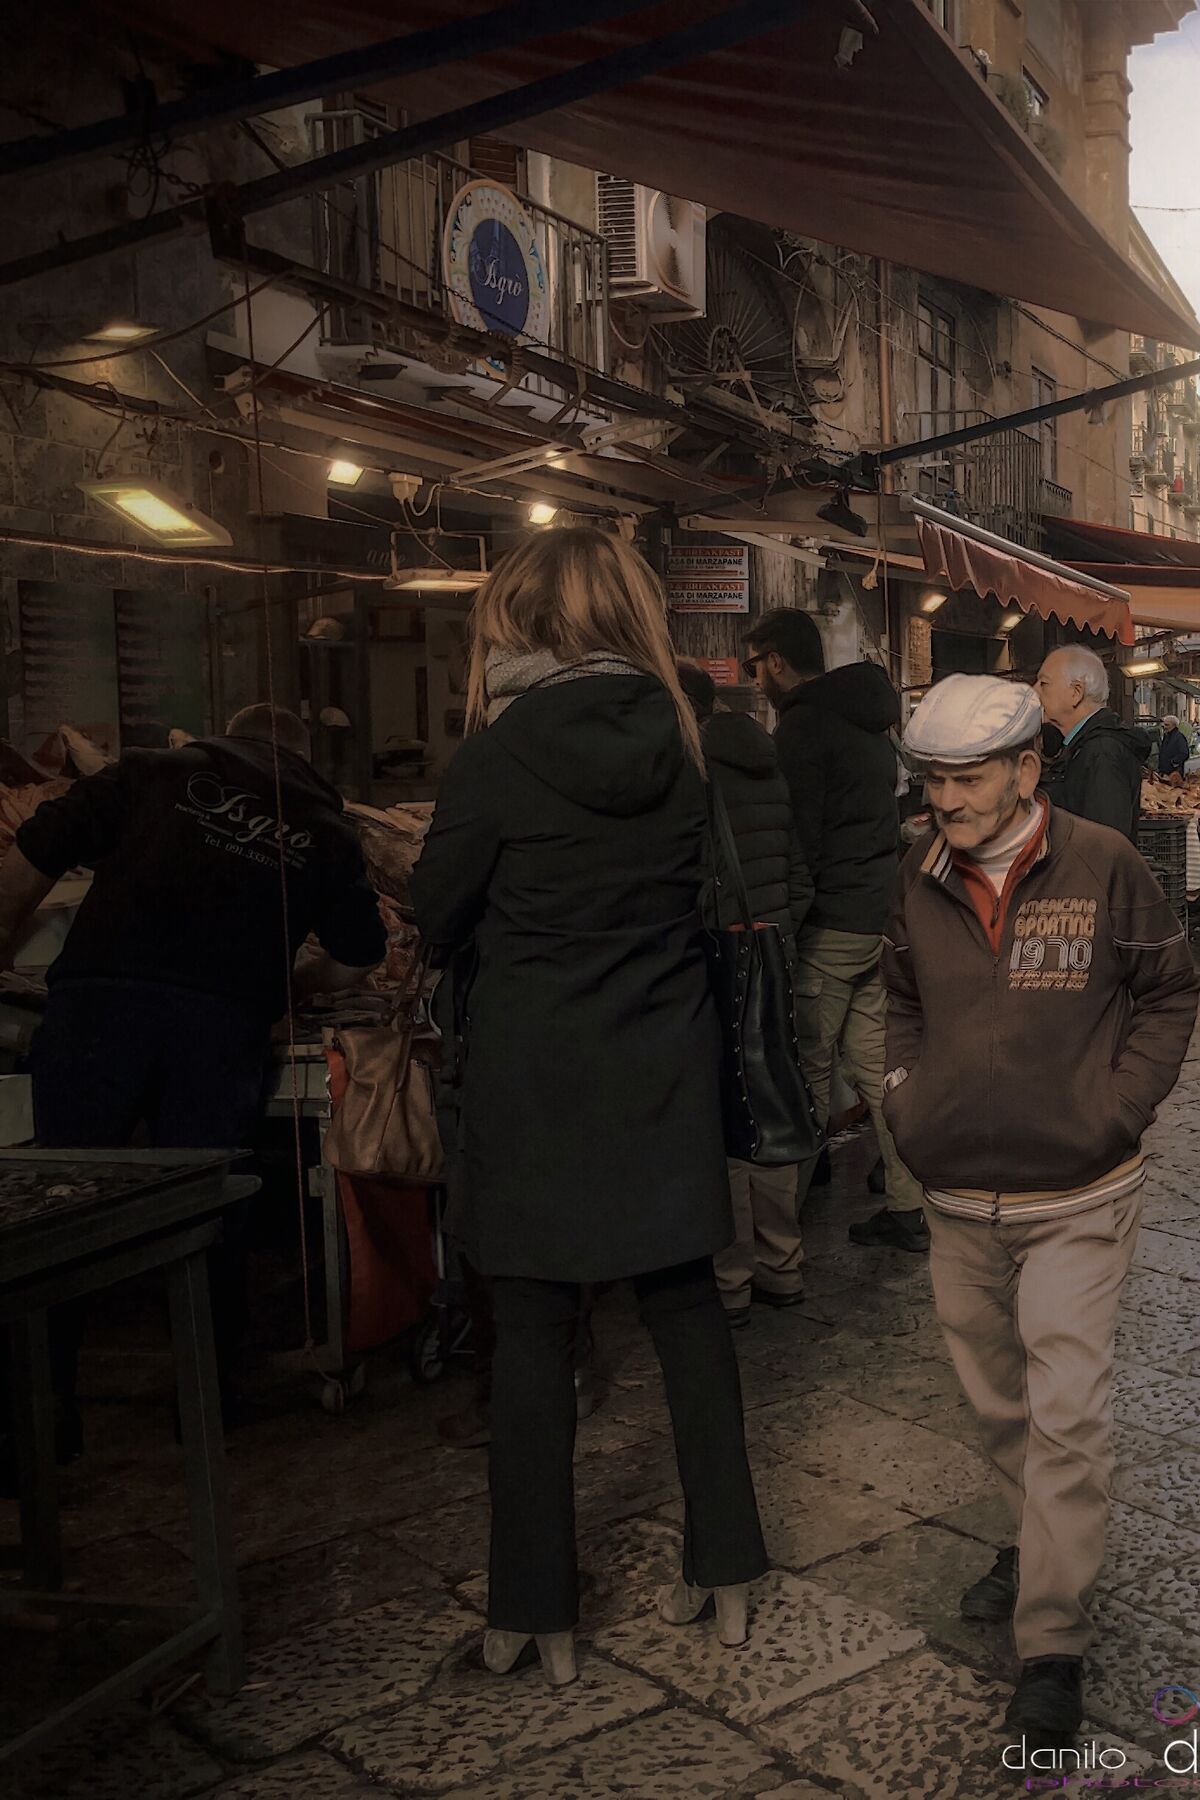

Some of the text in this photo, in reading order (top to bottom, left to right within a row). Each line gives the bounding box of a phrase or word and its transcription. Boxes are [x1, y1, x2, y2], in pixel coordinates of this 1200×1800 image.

[696, 558, 743, 566] MARZAPANE
[696, 592, 743, 600] MARZAPANE
[1014, 913, 1096, 938] SPORTING
[1009, 936, 1093, 972] 1970
